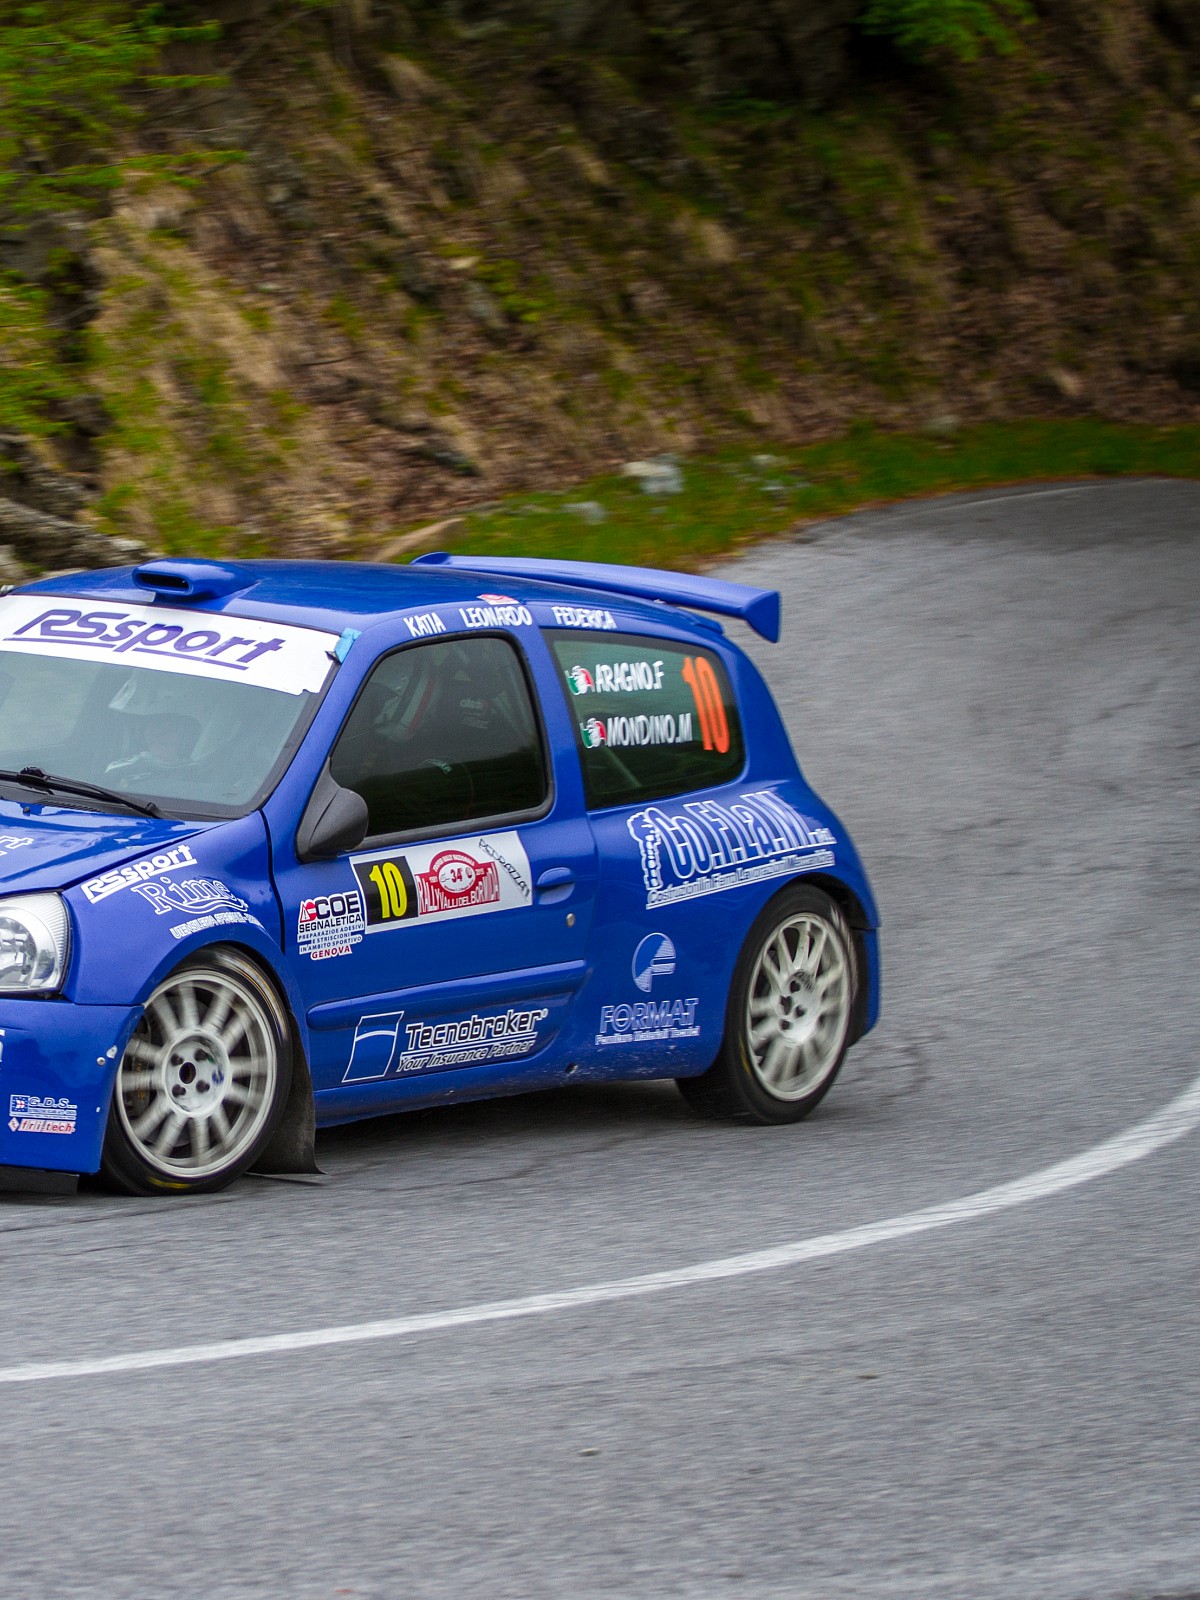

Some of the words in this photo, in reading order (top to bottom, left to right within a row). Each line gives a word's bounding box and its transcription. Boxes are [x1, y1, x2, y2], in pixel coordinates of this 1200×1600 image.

[403, 612, 447, 637] KATIA
[459, 605, 533, 628] LEONARDO
[552, 606, 618, 629] FEDERICA
[681, 656, 730, 753] 10
[369, 862, 407, 918] 10
[315, 892, 360, 920] COE
[299, 913, 362, 934] SEGNALETICA
[340, 923, 364, 933] ADESIVI
[308, 941, 332, 951] AMBITO
[317, 932, 351, 943] STRISCIONI
[312, 945, 350, 959] GENOVA
[405, 1008, 542, 1051] Tecnobroker
[397, 1055, 428, 1073] Your
[426, 1049, 489, 1068] Insurance
[487, 1040, 536, 1058] Partner
